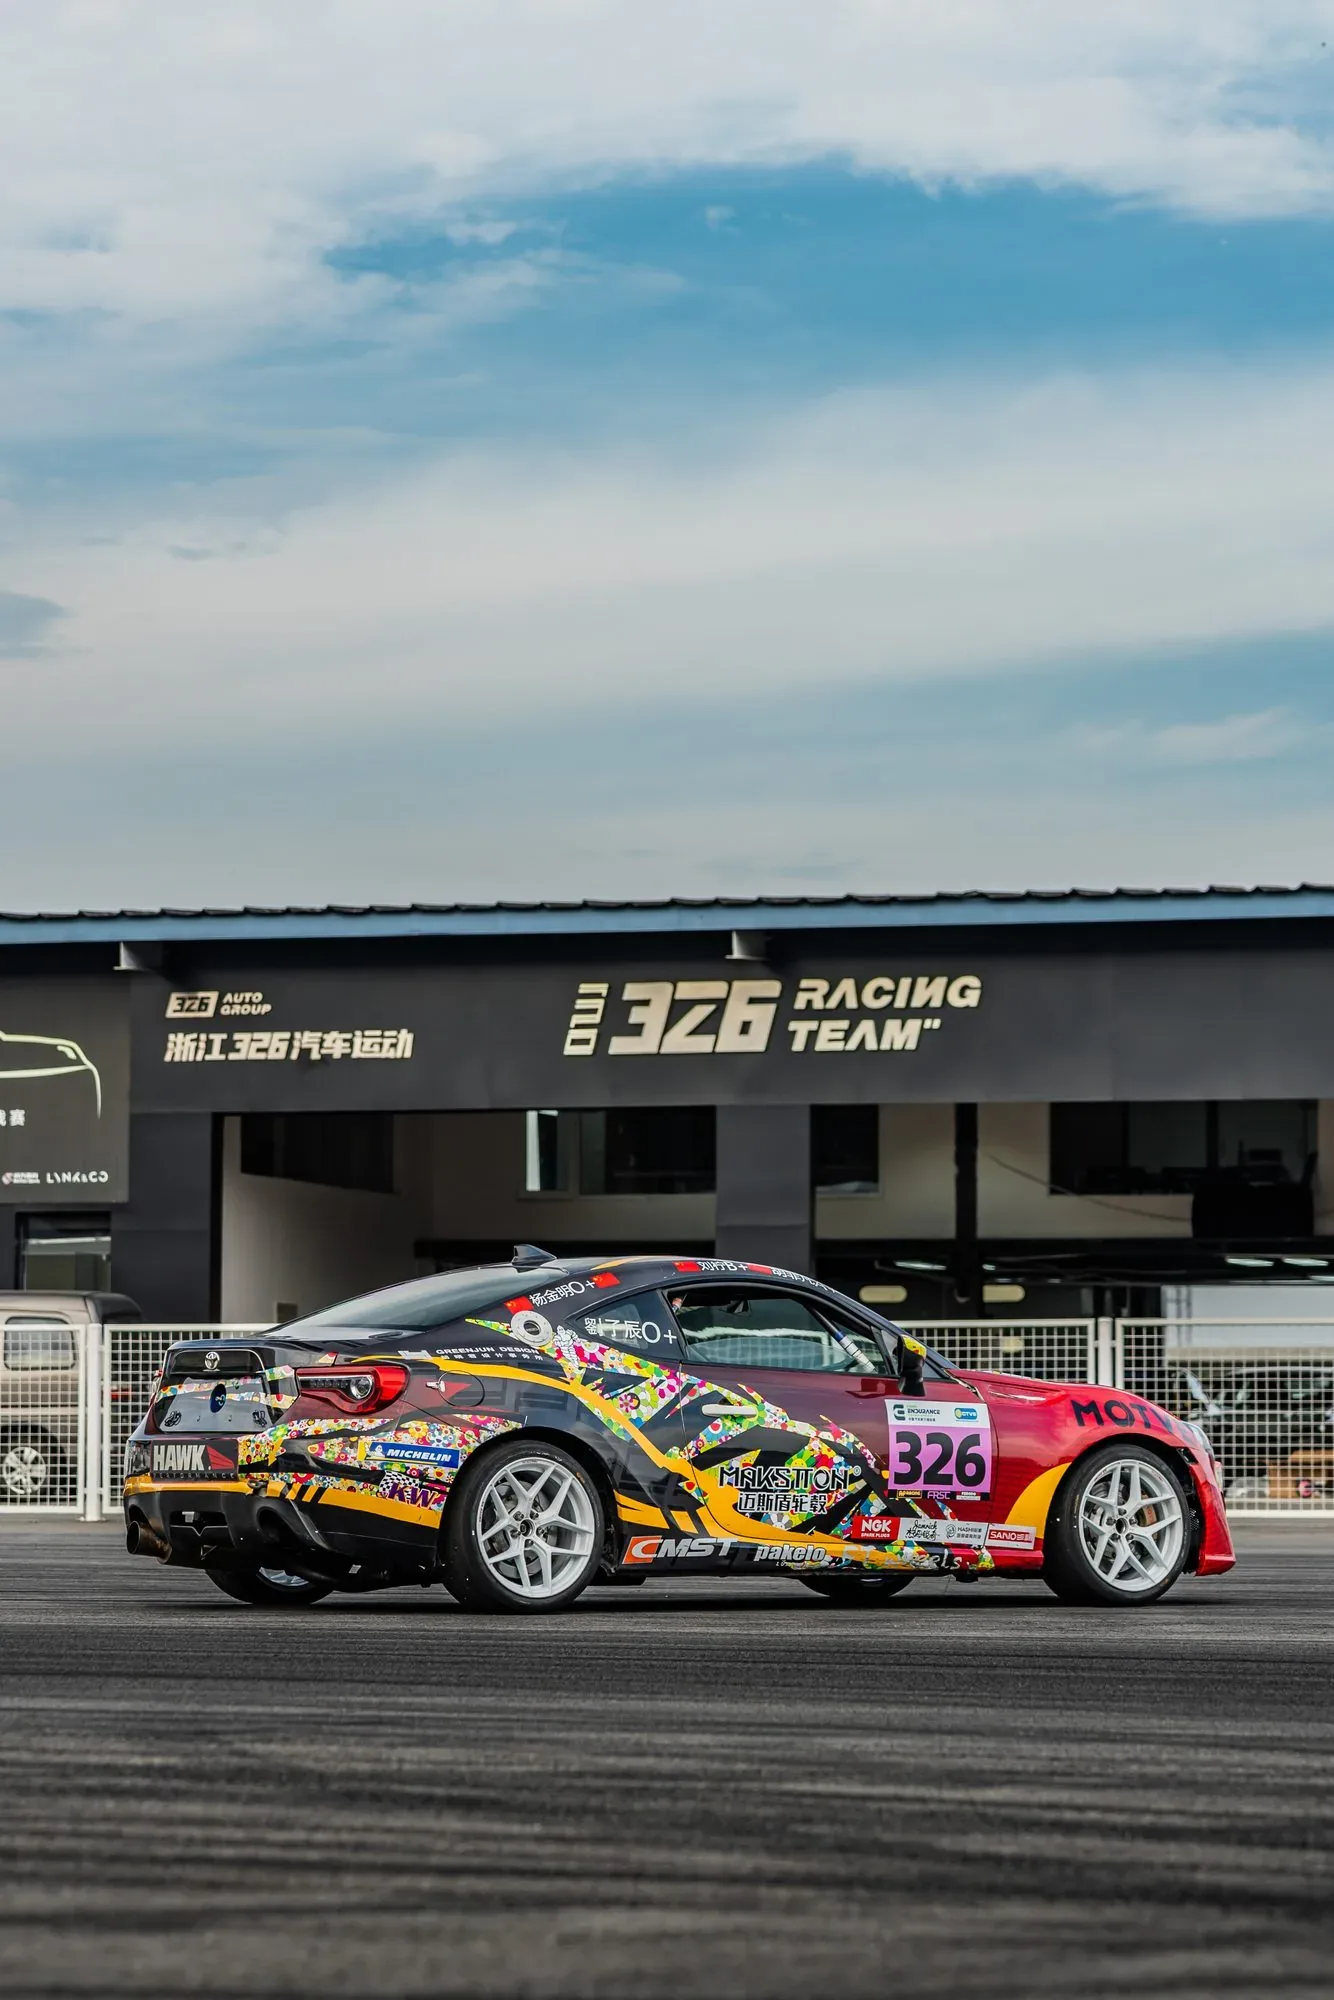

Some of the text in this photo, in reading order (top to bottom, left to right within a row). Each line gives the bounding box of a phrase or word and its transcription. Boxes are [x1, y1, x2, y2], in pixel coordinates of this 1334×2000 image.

[223, 992, 263, 1003] AUTO
[794, 975, 982, 1009] RACING
[173, 996, 210, 1012] 326
[220, 1004, 272, 1015] GROUP
[607, 980, 782, 1055] 326
[164, 1029, 414, 1062] 浙江326汽车运动
[436, 1347, 540, 1355] GREENJUN DESIGN
[153, 1444, 206, 1471] HAWK
[387, 1448, 452, 1462] MICHELIN
[894, 1431, 986, 1487] 326
[387, 1481, 435, 1509] KW
[737, 1491, 828, 1515] 迈斯盾轮毂
[861, 1519, 892, 1533] NGK
[631, 1537, 738, 1560] CMST
[753, 1544, 826, 1562] pakelo
